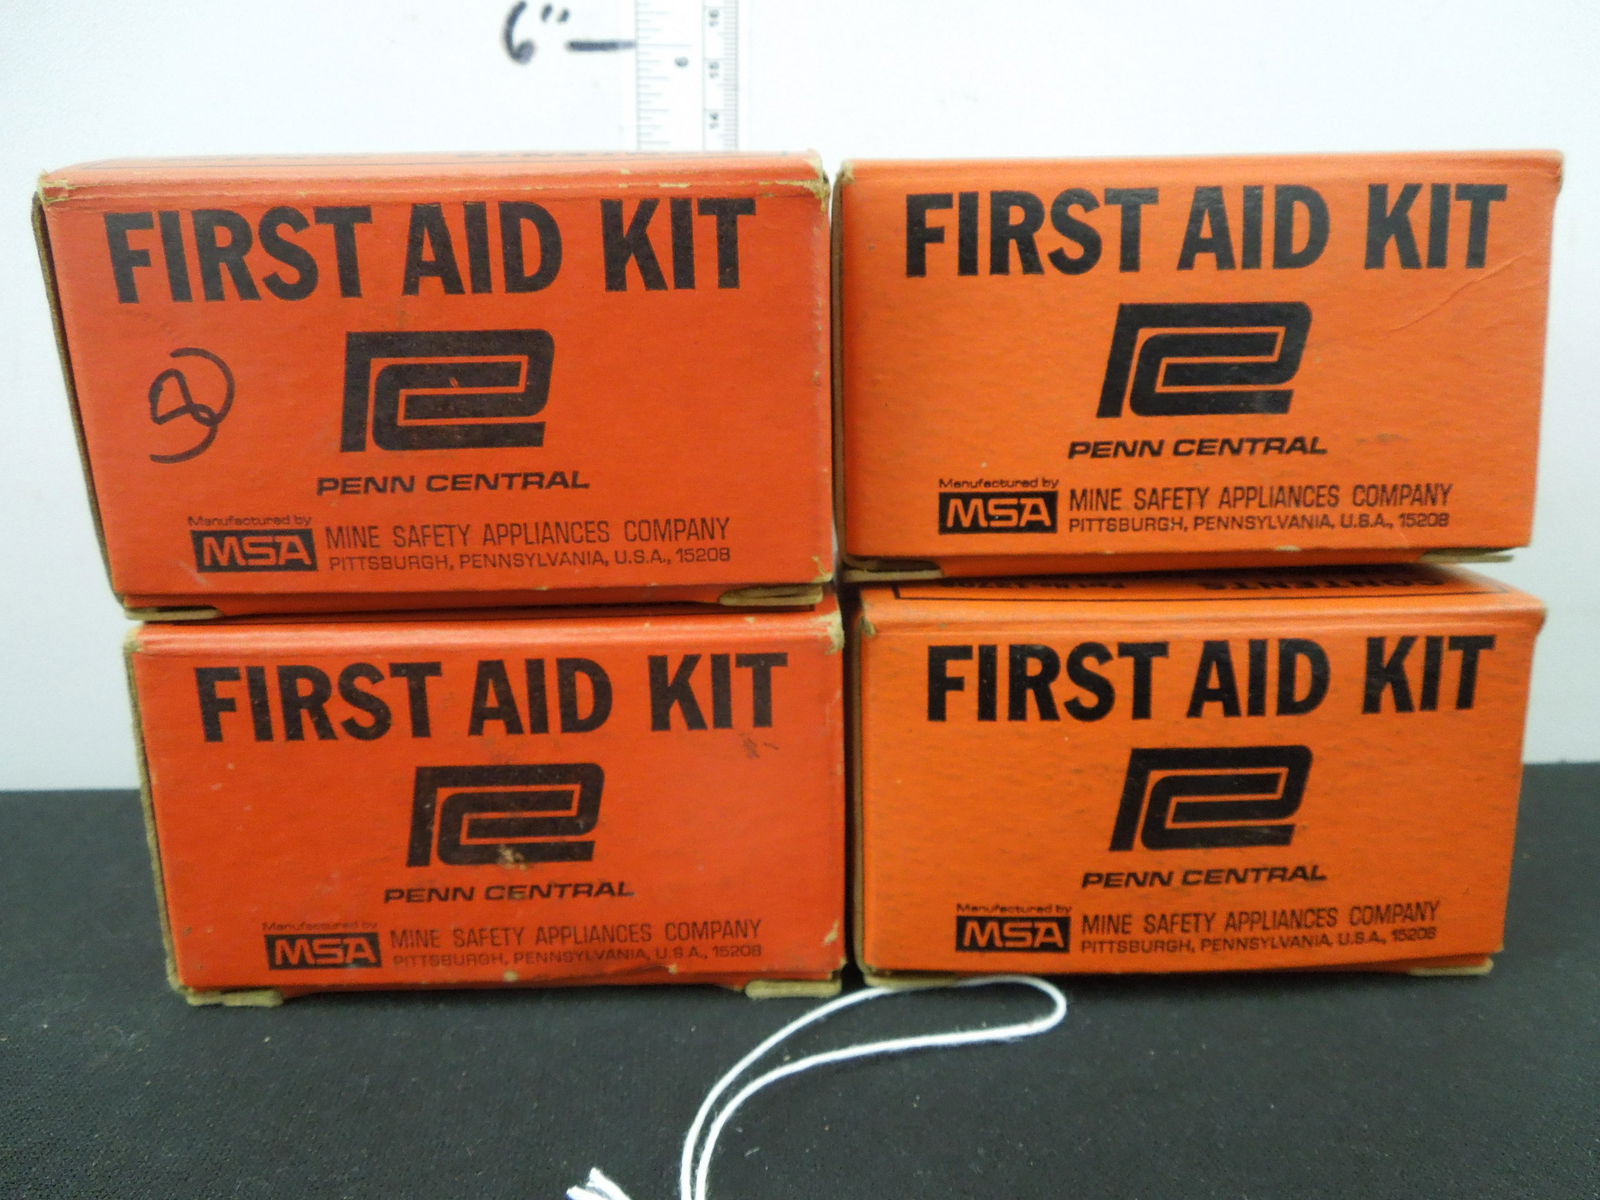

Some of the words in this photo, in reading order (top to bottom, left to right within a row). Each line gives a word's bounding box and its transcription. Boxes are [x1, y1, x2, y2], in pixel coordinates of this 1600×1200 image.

[674, 56, 689, 68] 6
[906, 187, 1159, 277] FIRST
[1177, 184, 1330, 270] AID
[1364, 183, 1507, 269] KIT
[104, 206, 372, 303] FIRST
[402, 201, 562, 296] AID
[601, 197, 756, 292] KIT
[1068, 440, 1164, 459] PENN
[1173, 436, 1328, 456] CENTRAL
[317, 475, 415, 496] PENN
[425, 471, 590, 491] CENTRAL
[938, 478, 1038, 489] Manufactured
[1041, 477, 1060, 491] by
[1069, 487, 1122, 511] MINE
[1134, 486, 1210, 510] SAFETY
[1218, 484, 1340, 508] APPLIANCES
[1352, 482, 1453, 507] COMPANY
[187, 515, 291, 527] Manufactured
[294, 514, 312, 527] by
[946, 498, 1051, 528] MSA
[1069, 517, 1188, 532] PITTSBURGH,
[1399, 512, 1449, 528] 15208
[326, 525, 379, 549] MINE
[393, 523, 471, 548] SAFETY
[483, 520, 610, 546] APPLIANCES
[624, 517, 730, 542] COMPANY
[203, 534, 313, 567] MSA
[329, 554, 454, 571] PITTSBURGH,
[676, 547, 731, 562] 15208
[927, 641, 1170, 722] FIRST
[1186, 638, 1330, 718] AID
[1361, 634, 1496, 714] KIT
[194, 661, 442, 742] FIRST
[467, 657, 612, 736] AID
[648, 652, 788, 731] KIT
[1081, 871, 1174, 888] PENN
[1181, 865, 1327, 886] CENTRAL
[384, 886, 475, 904] PENN
[484, 881, 635, 901] CENTRAL
[956, 903, 1053, 914] Manufactured
[1056, 904, 1072, 915] by
[1082, 914, 1132, 935] MINE
[1143, 912, 1215, 934] SAFETY
[1225, 907, 1338, 931] APPLIANCES
[1349, 900, 1440, 925] COMPANY
[390, 928, 440, 949] MINE
[453, 926, 524, 948] SAFETY
[535, 923, 652, 945] APPLIANCES
[665, 919, 762, 941] COMPANY
[963, 920, 1064, 948] MSA
[1081, 938, 1195, 953] PITTSBURGH,
[275, 936, 379, 965] MSA
[713, 944, 762, 958] 15208
